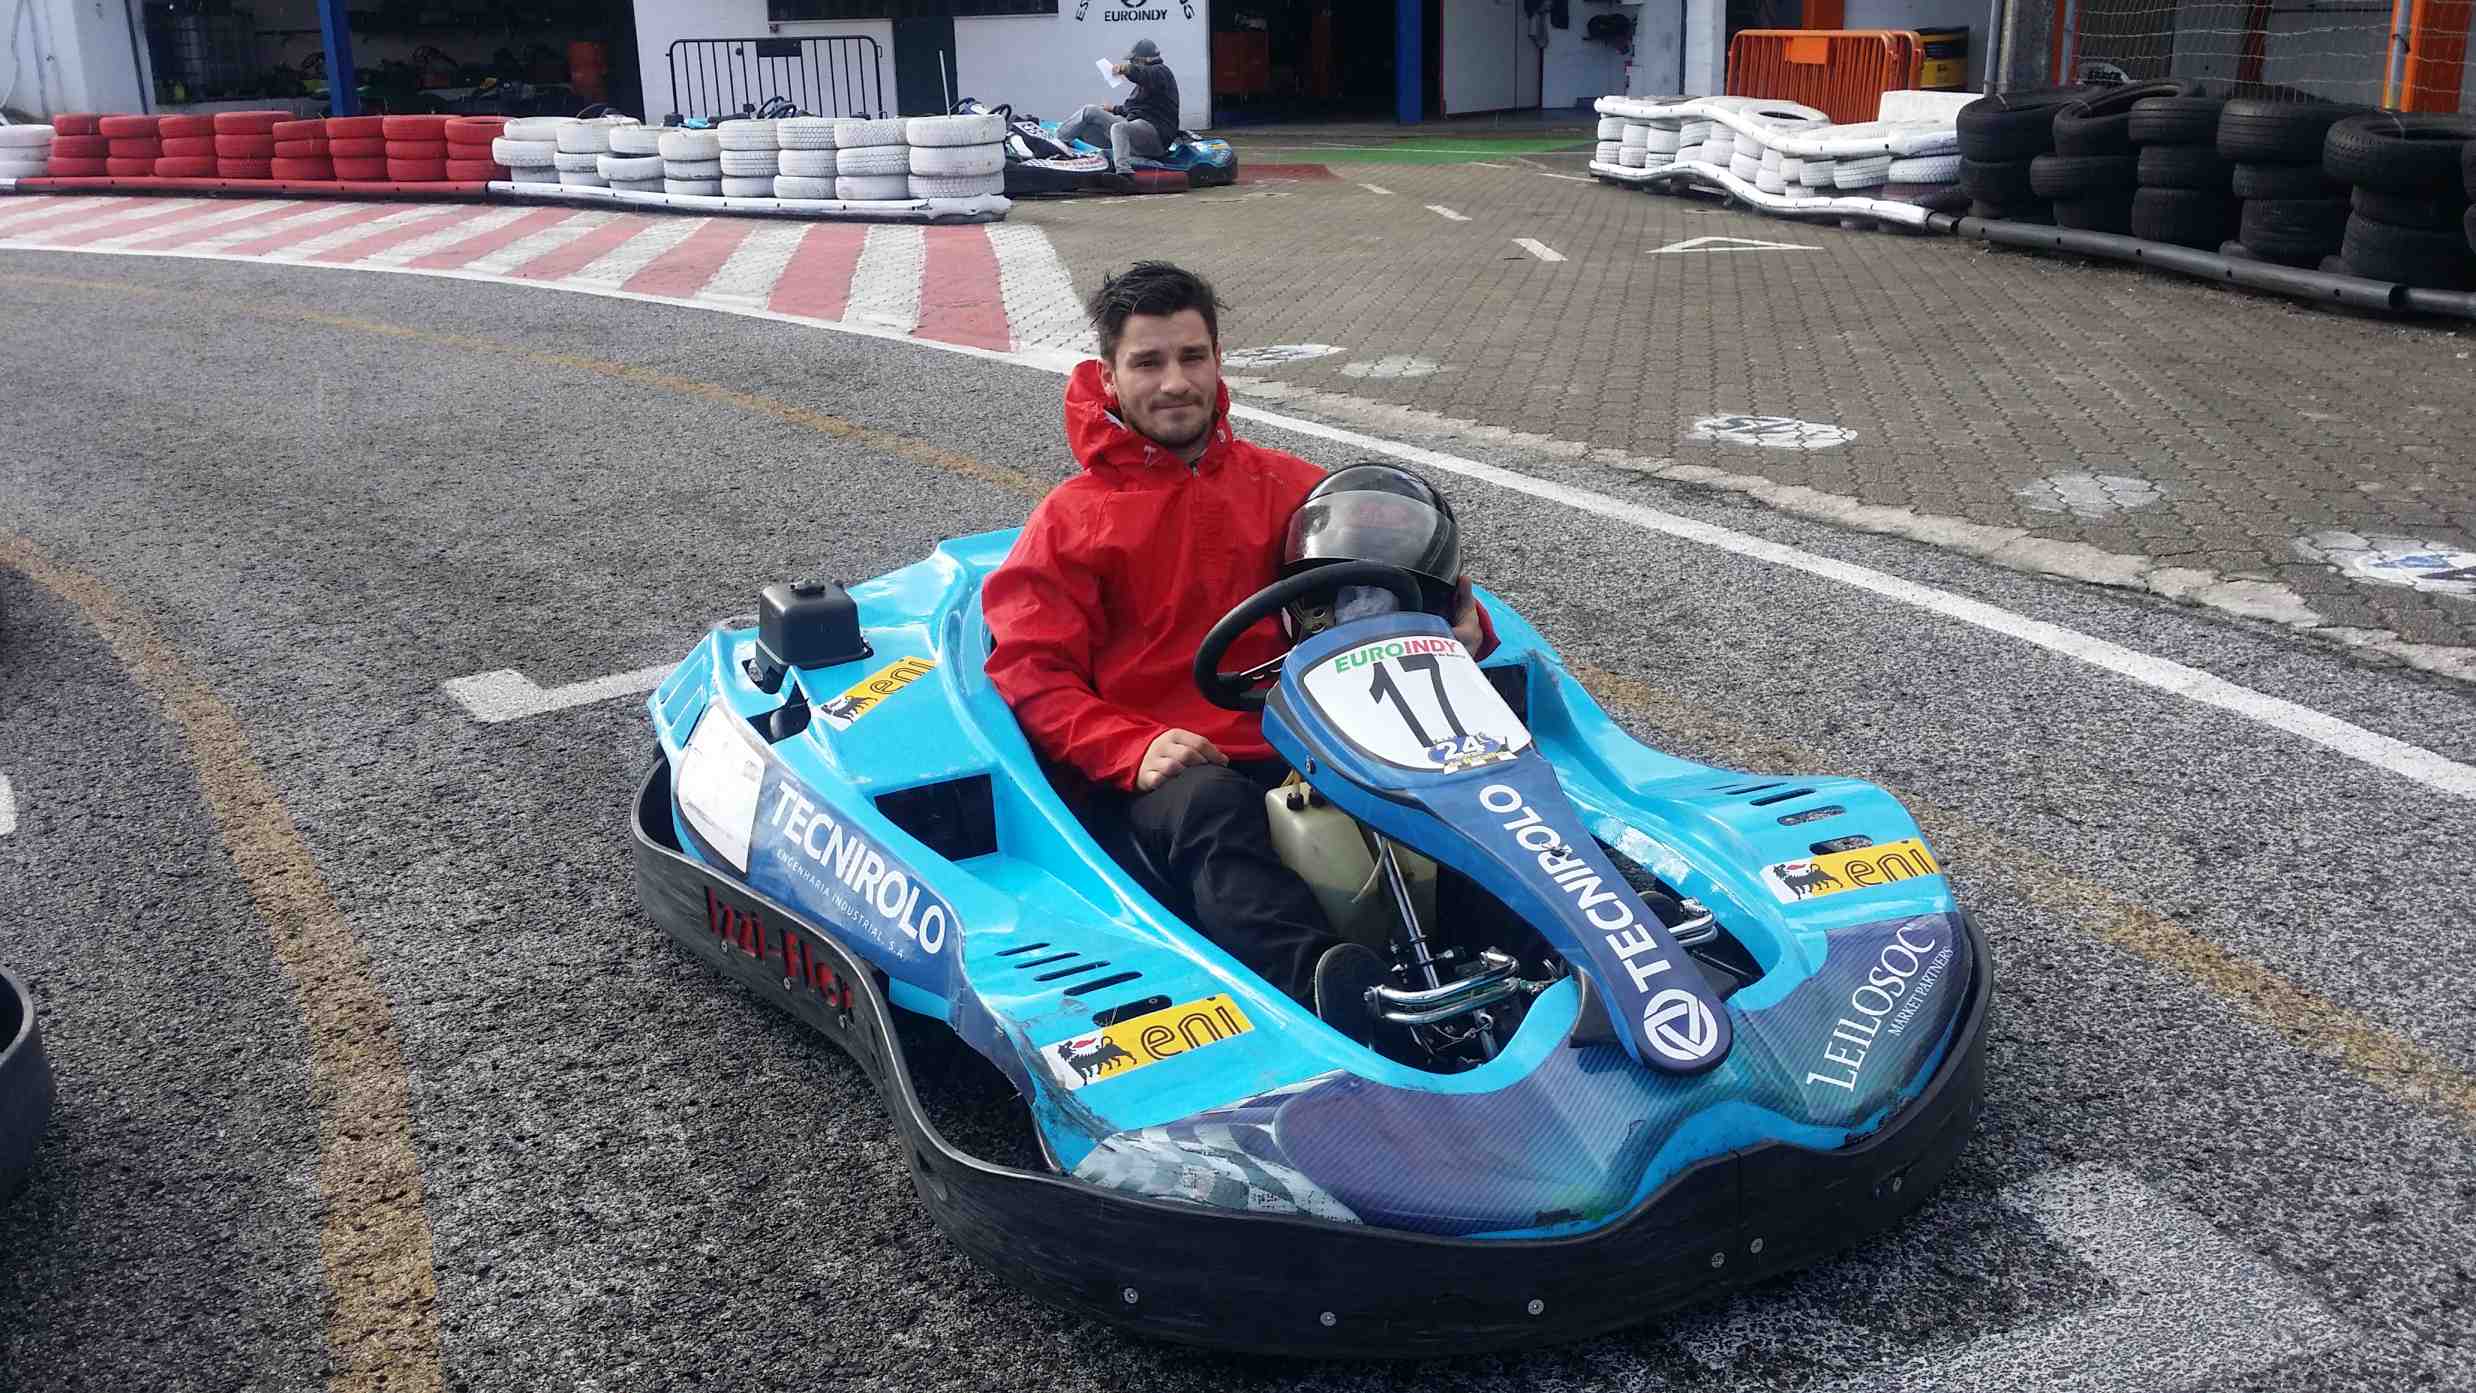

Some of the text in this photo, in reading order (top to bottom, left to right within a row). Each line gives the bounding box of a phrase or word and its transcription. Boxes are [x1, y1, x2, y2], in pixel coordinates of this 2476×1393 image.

[1104, 9, 1168, 22] EUROINDY
[869, 658, 937, 694] eni
[1335, 639, 1457, 674] EUROINDY
[1369, 652, 1468, 748] 17
[772, 781, 946, 955] TECNIROLO
[776, 848, 830, 898] ENGENHARIA
[1479, 784, 1671, 993] TECNIROLO
[1844, 840, 1935, 887] eni
[1806, 923, 1936, 1092] LEILOSOC
[1887, 944, 1954, 1037] MARKET PARTNERS
[1140, 996, 1243, 1060] eni
